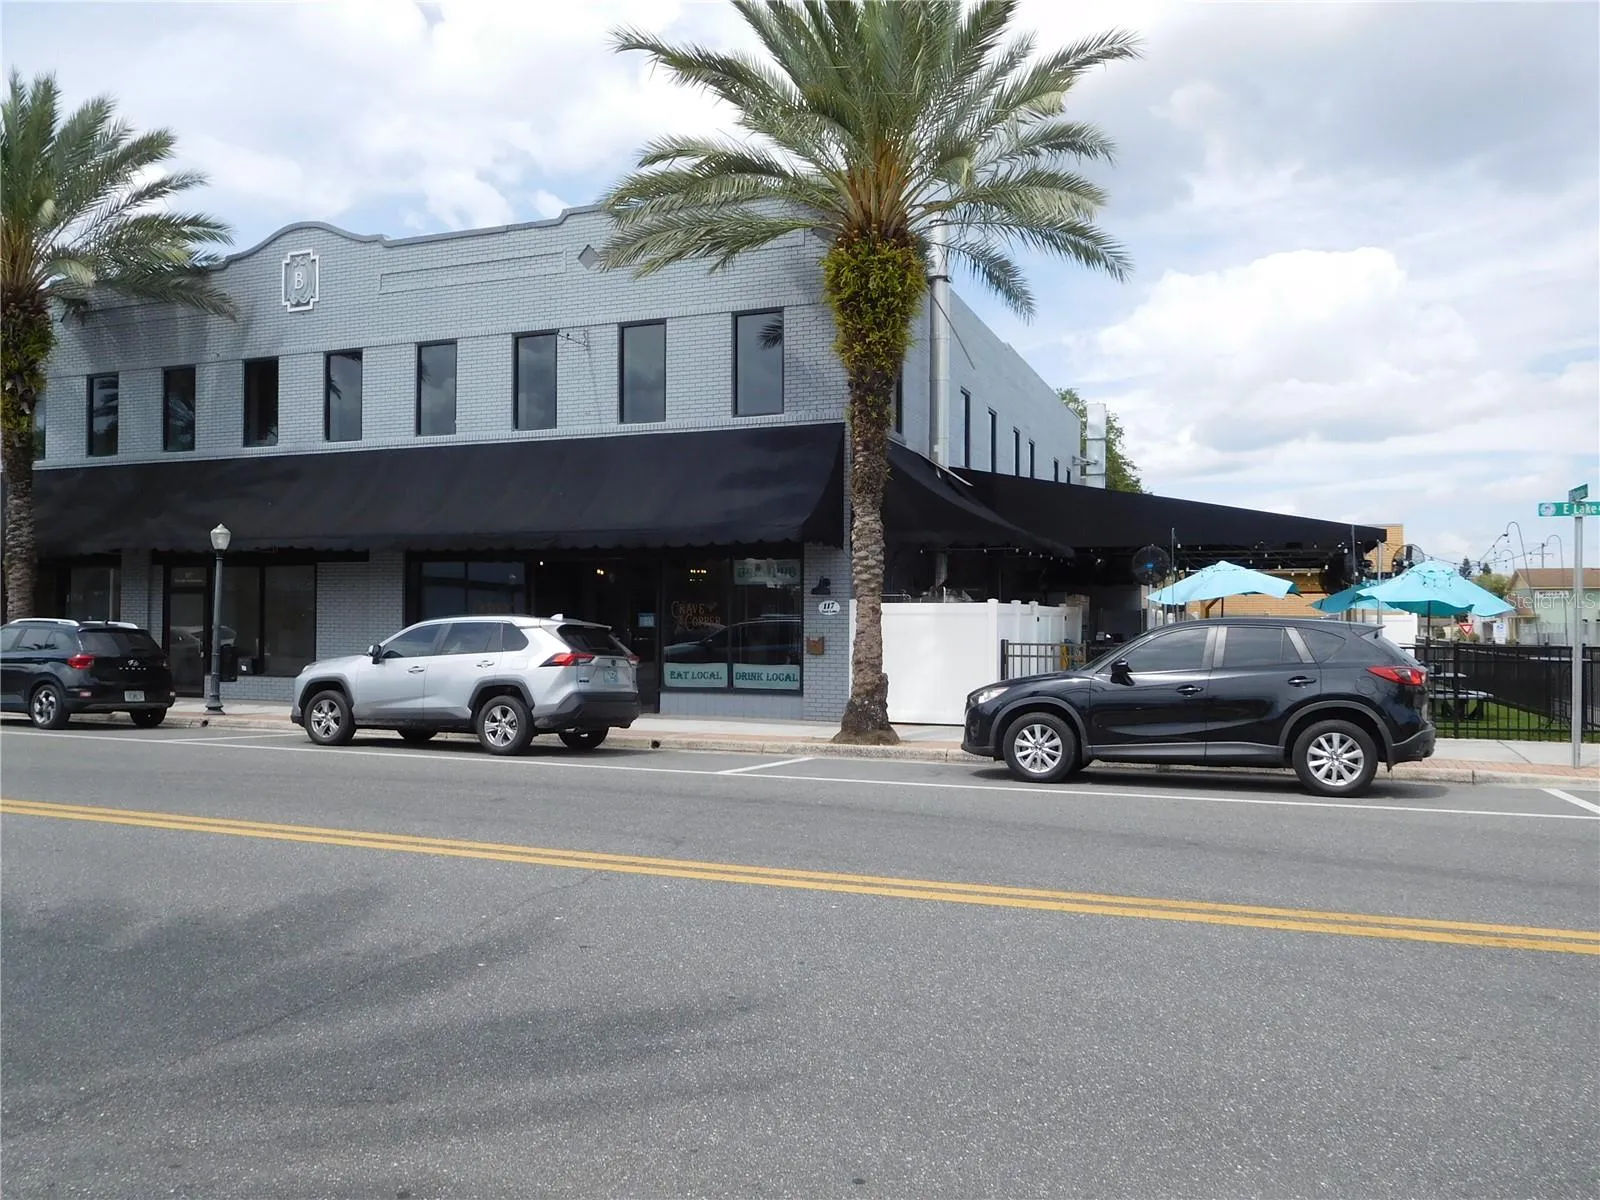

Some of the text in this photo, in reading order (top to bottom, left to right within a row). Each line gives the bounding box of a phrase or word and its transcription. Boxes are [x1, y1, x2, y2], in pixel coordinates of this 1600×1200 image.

[1563, 503, 1597, 514] E Lake
[823, 602, 835, 610] 117
[670, 670, 722, 680] EAT LOCAL
[735, 671, 798, 682] DRINK LOCAL
